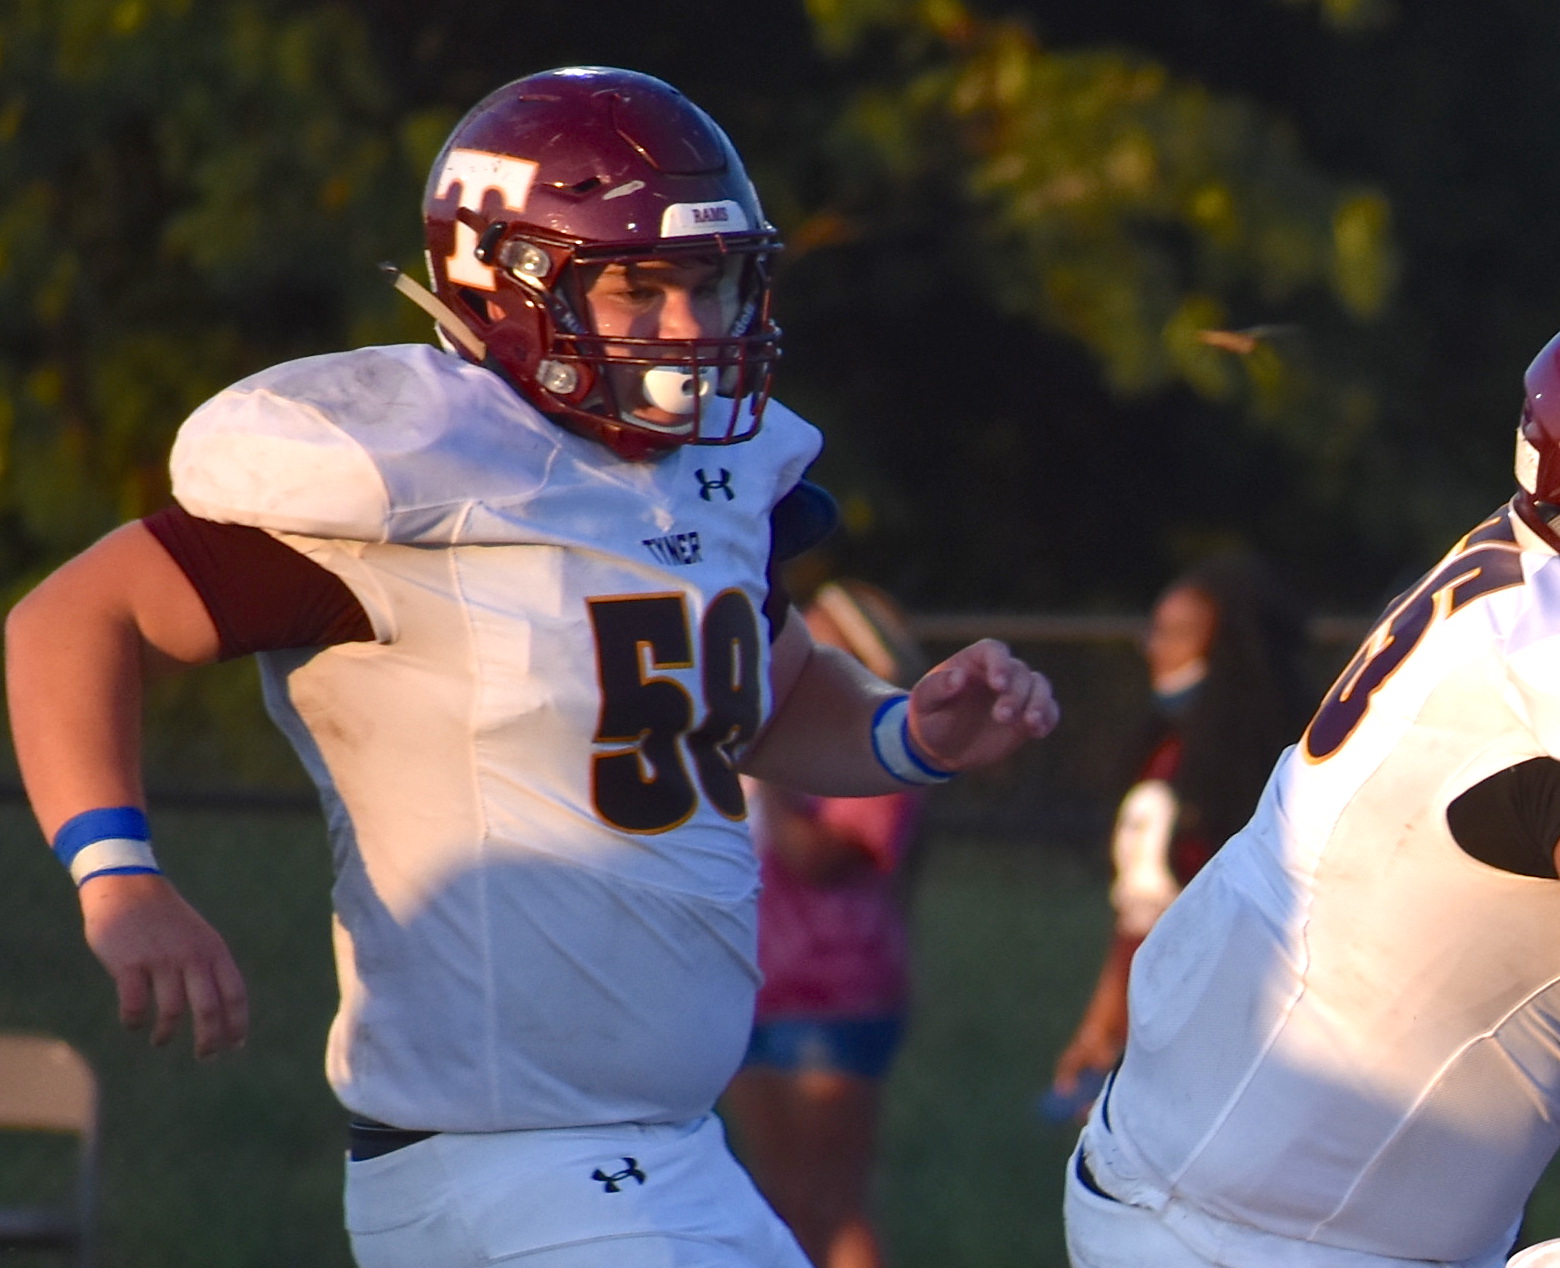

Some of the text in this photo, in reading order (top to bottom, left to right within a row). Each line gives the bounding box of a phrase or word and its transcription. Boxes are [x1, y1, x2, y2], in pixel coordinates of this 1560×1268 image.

[434, 147, 541, 293] T
[692, 207, 728, 223] RAMS
[641, 531, 703, 566] TYNER
[584, 586, 761, 835] 58
